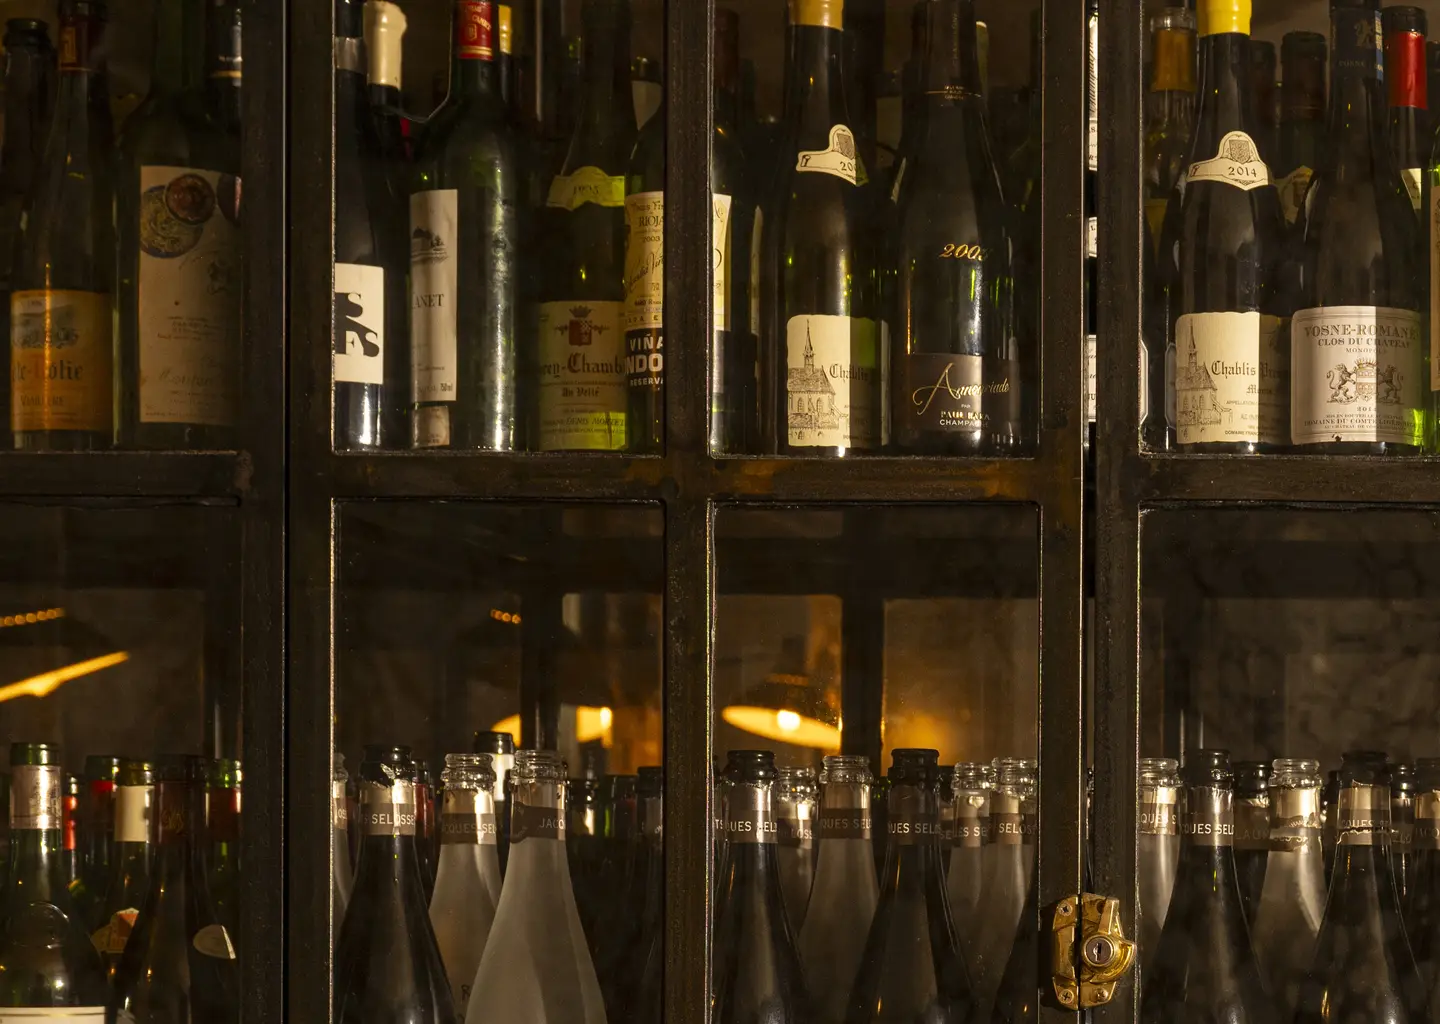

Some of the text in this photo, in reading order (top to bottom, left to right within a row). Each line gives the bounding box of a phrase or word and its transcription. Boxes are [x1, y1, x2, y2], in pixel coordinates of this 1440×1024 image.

[1228, 165, 1257, 178] 2014
[630, 333, 664, 350] VIÑA
[1318, 337, 1363, 347] CLOS DU
[1211, 360, 1257, 379] Chablis
